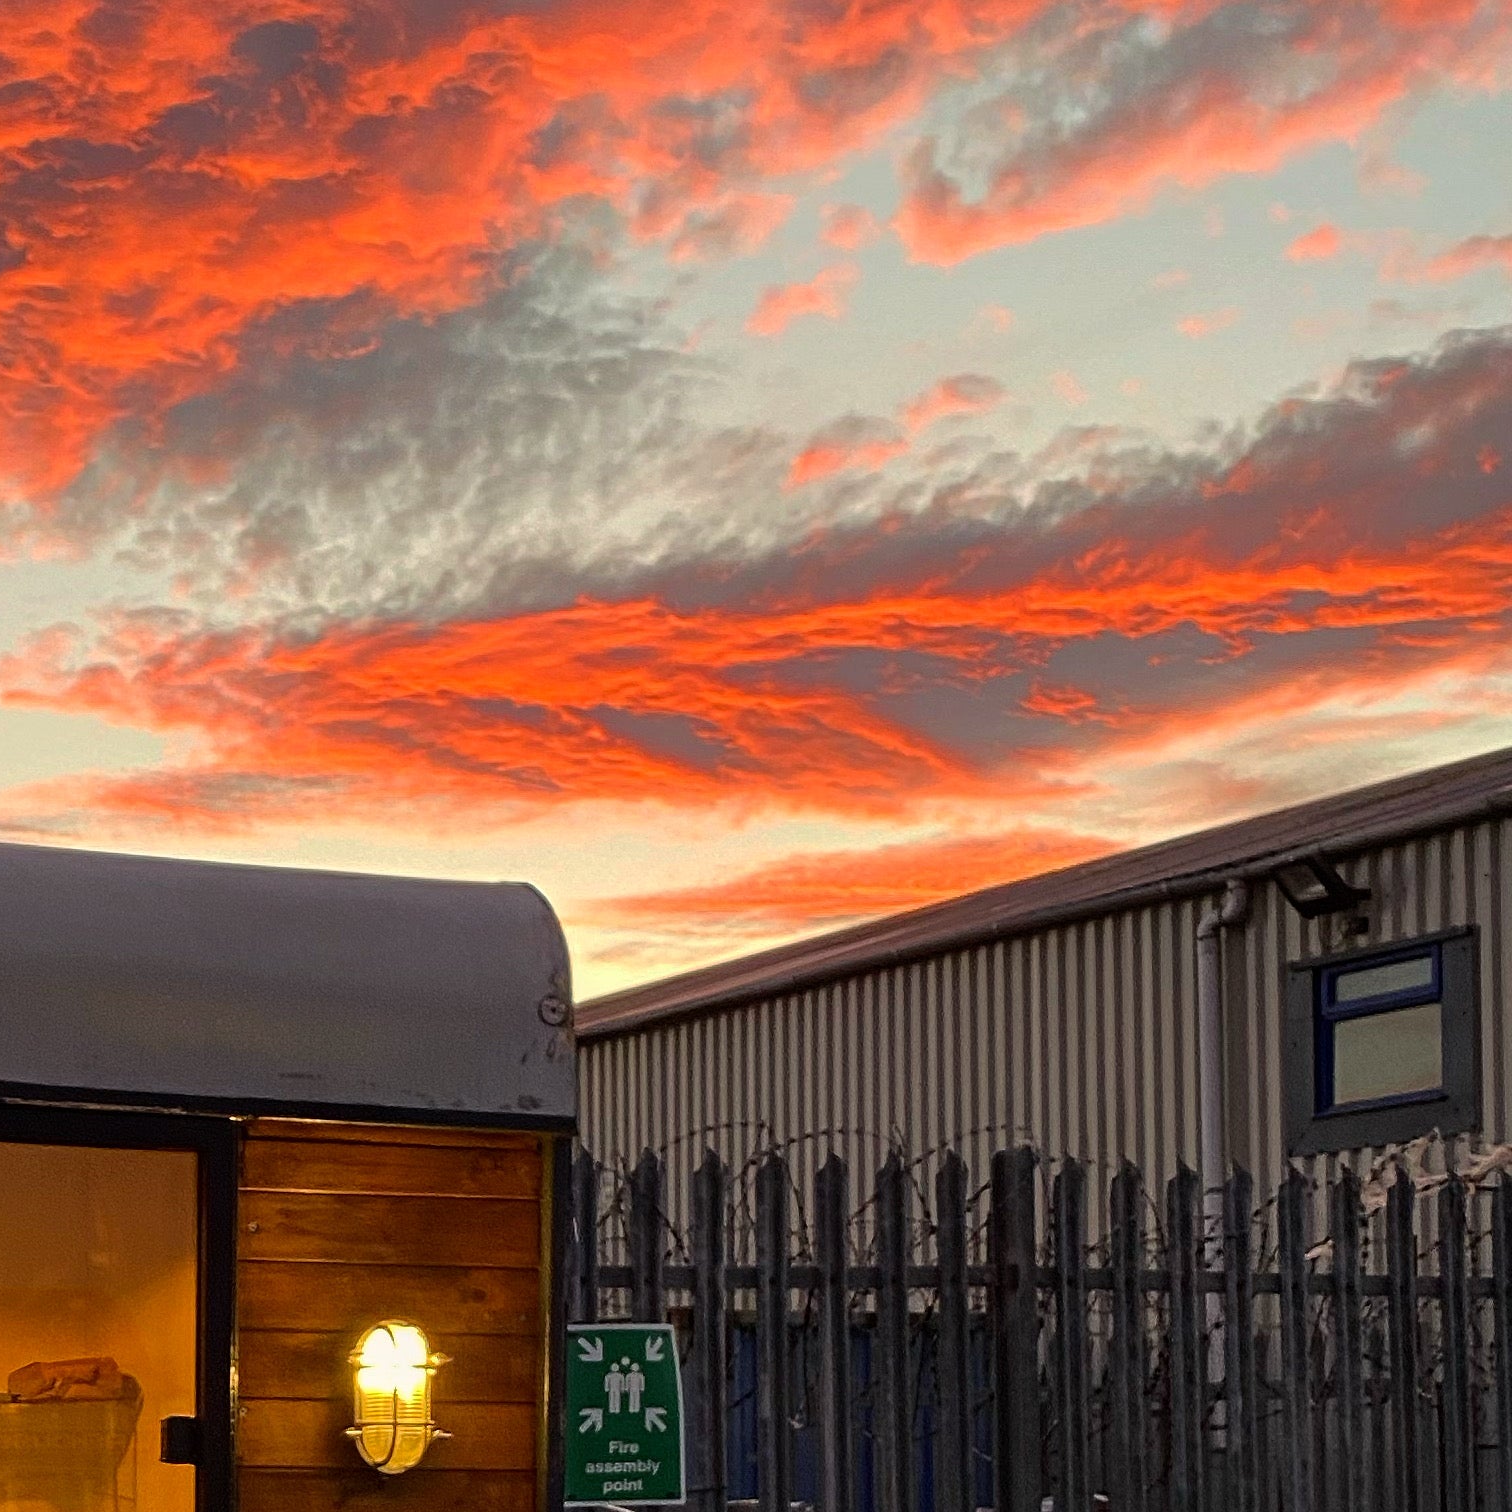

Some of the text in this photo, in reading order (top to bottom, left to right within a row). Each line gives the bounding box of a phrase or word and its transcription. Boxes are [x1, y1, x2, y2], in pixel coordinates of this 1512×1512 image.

[609, 1440, 640, 1454] Fire
[585, 1459, 661, 1476] assembly
[603, 1478, 643, 1495] point
